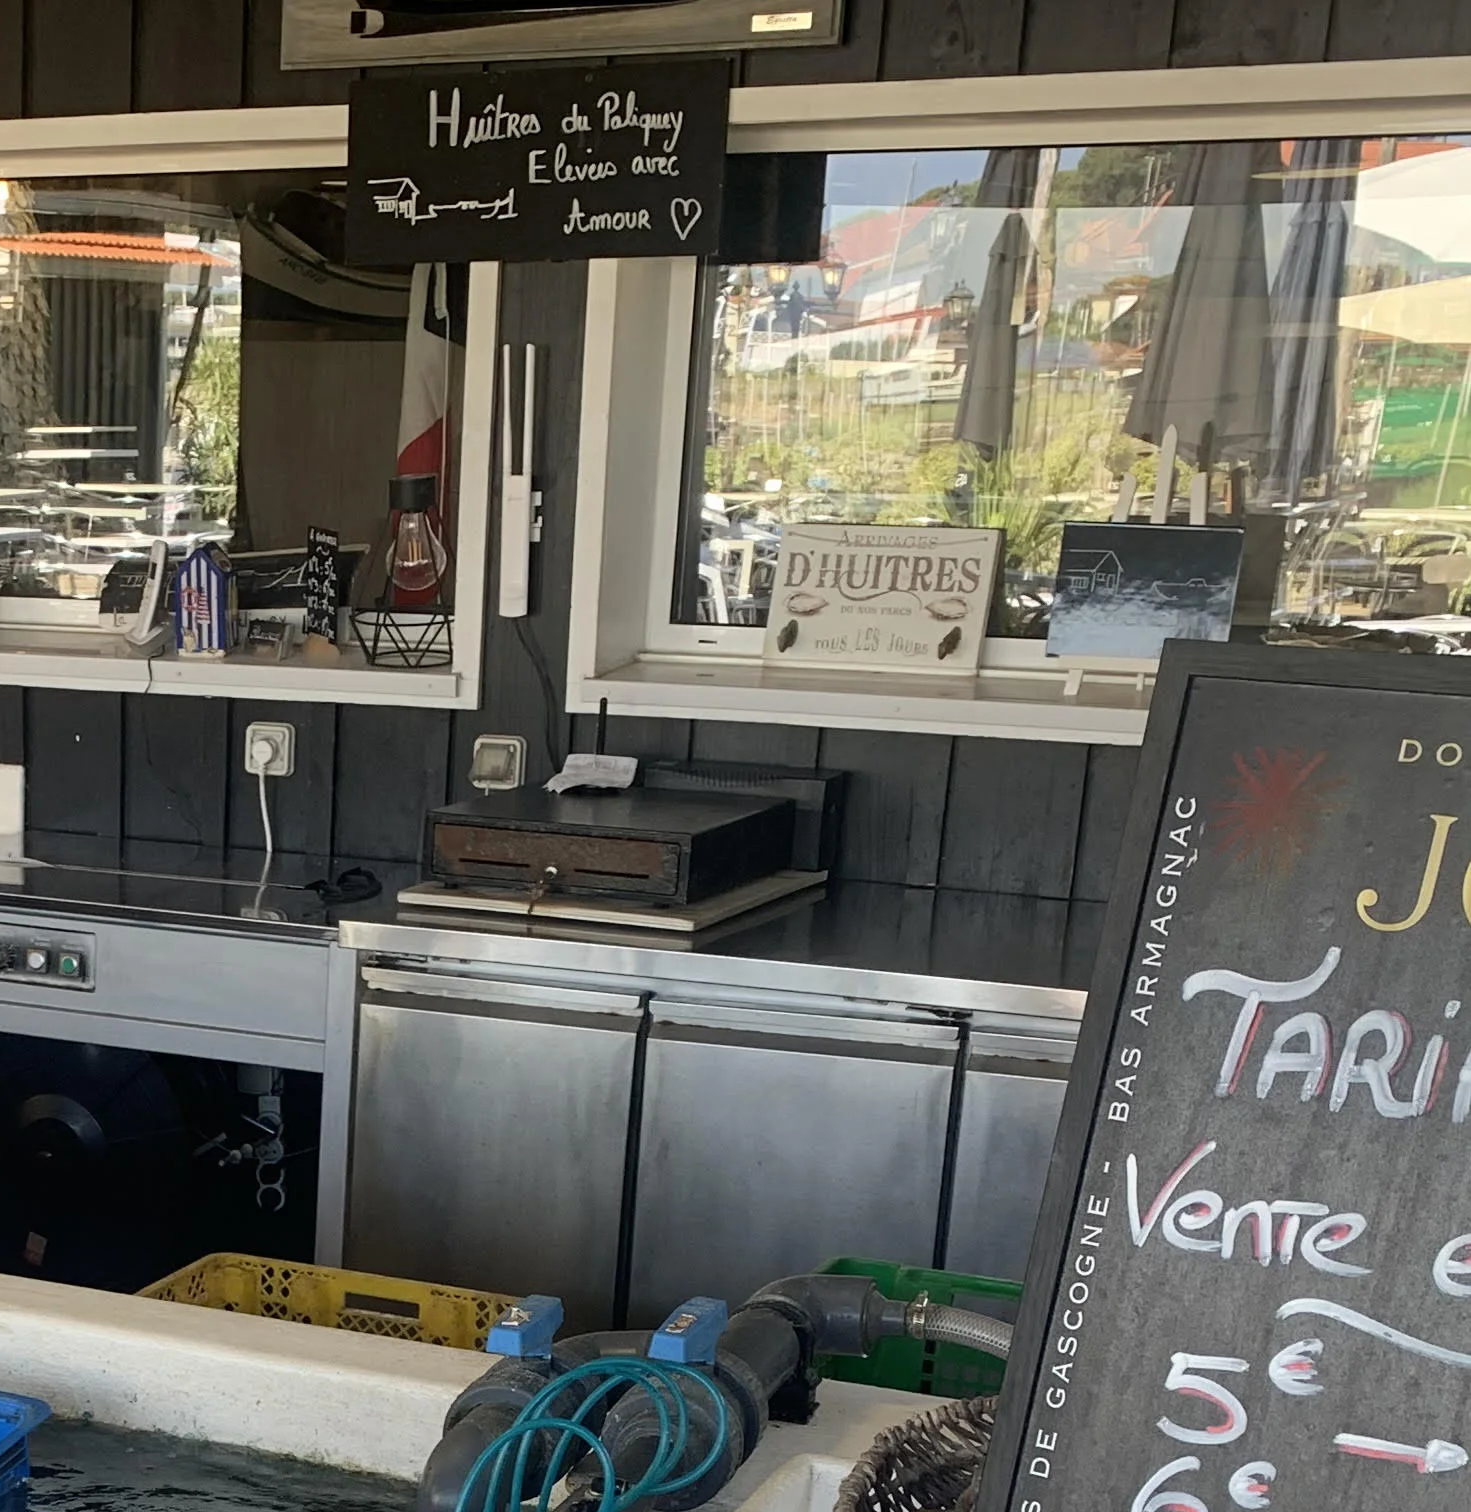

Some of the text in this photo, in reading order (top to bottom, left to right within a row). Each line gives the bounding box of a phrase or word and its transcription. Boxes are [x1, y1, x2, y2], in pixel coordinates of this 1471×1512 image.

[561, 103, 592, 134] du
[597, 90, 683, 153] Paliquey
[631, 155, 680, 177] avec
[784, 550, 981, 594] D'HUITRES
[1030, 1431, 1058, 1479] DE
[1046, 1194, 1111, 1409] GASCOGNE
[1107, 1046, 1142, 1122] BAS
[1130, 796, 1197, 1027] ARMAGNAC
